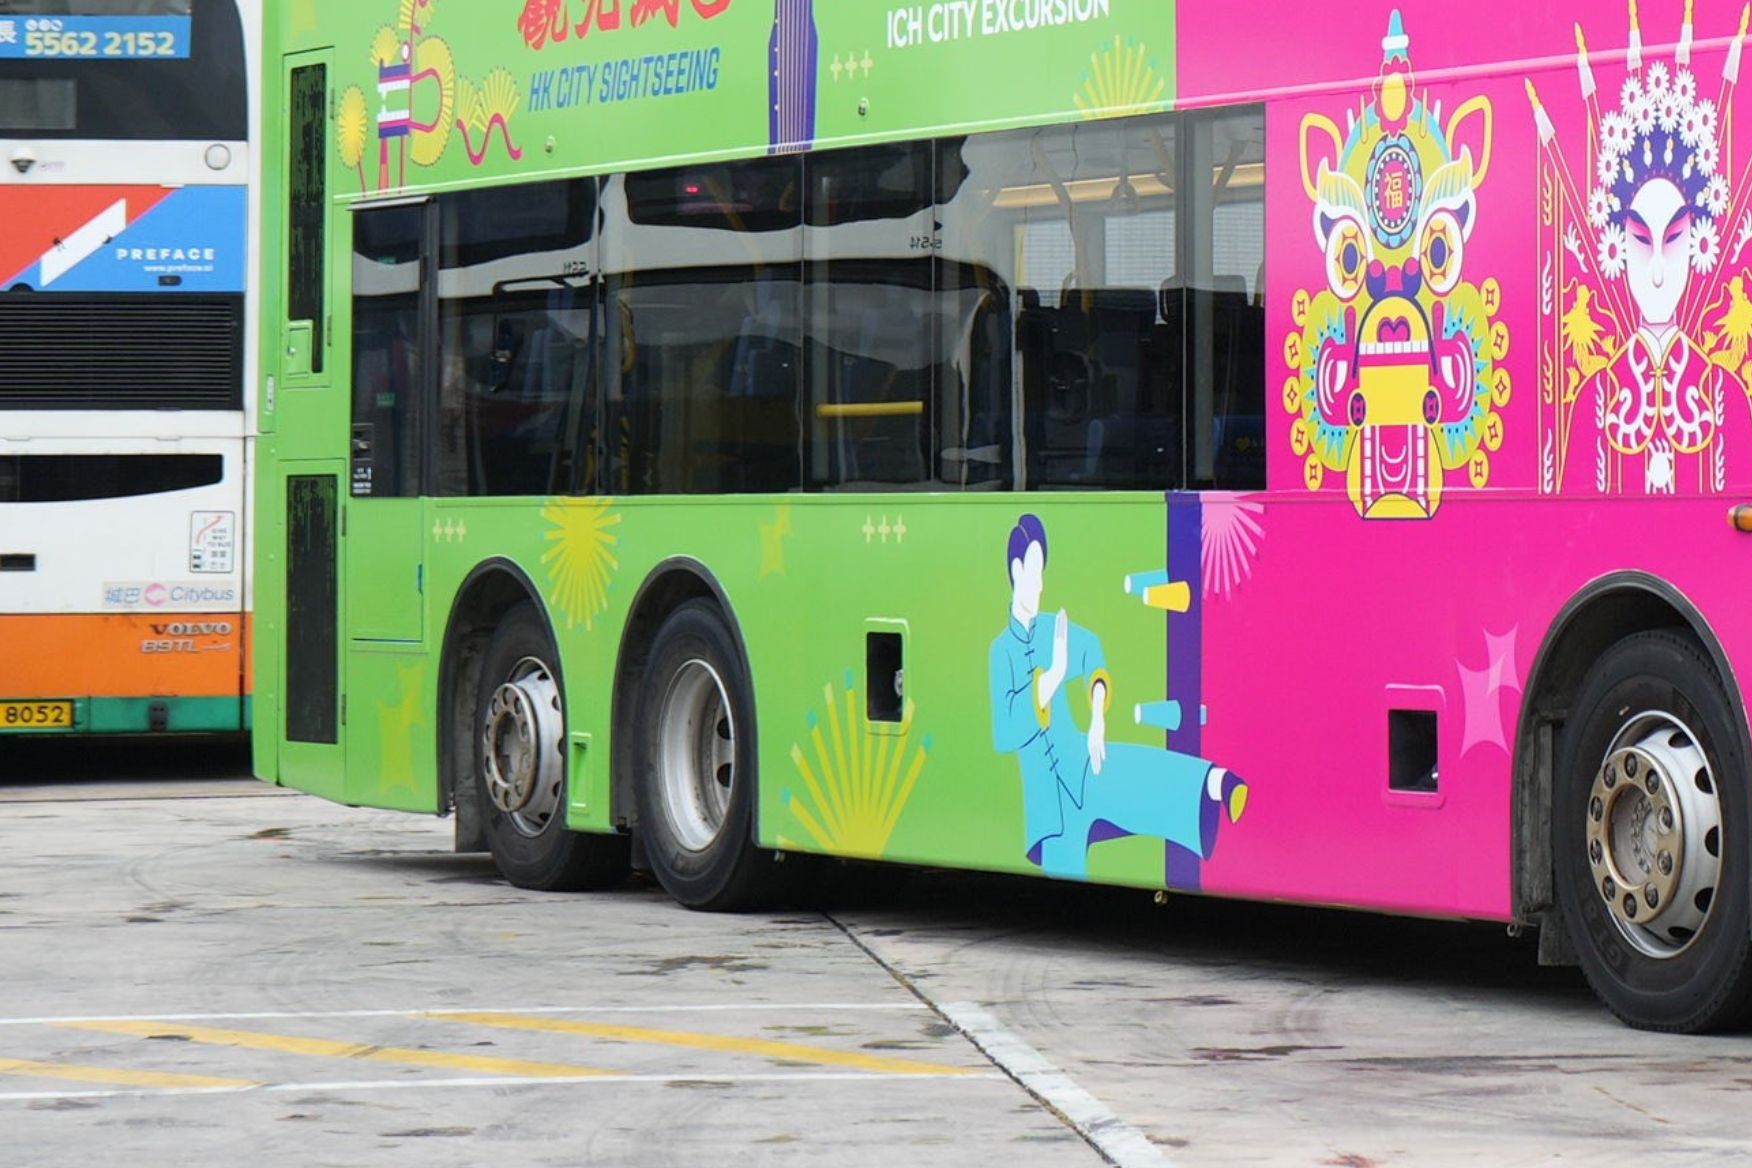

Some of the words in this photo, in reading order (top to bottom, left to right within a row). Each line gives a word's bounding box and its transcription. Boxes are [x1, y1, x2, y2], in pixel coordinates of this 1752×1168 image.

[887, 6, 923, 48] ICH
[25, 31, 98, 55] 5562
[103, 31, 176, 55] 2152
[528, 70, 555, 112] HK
[556, 63, 598, 109] CITY
[599, 46, 721, 103] SIGHTSEEING
[1383, 170, 1404, 210] 福
[116, 248, 216, 261] PREFACE
[170, 585, 235, 602] Citybus
[150, 622, 233, 636] VOLVO
[5, 705, 65, 724] 8052
